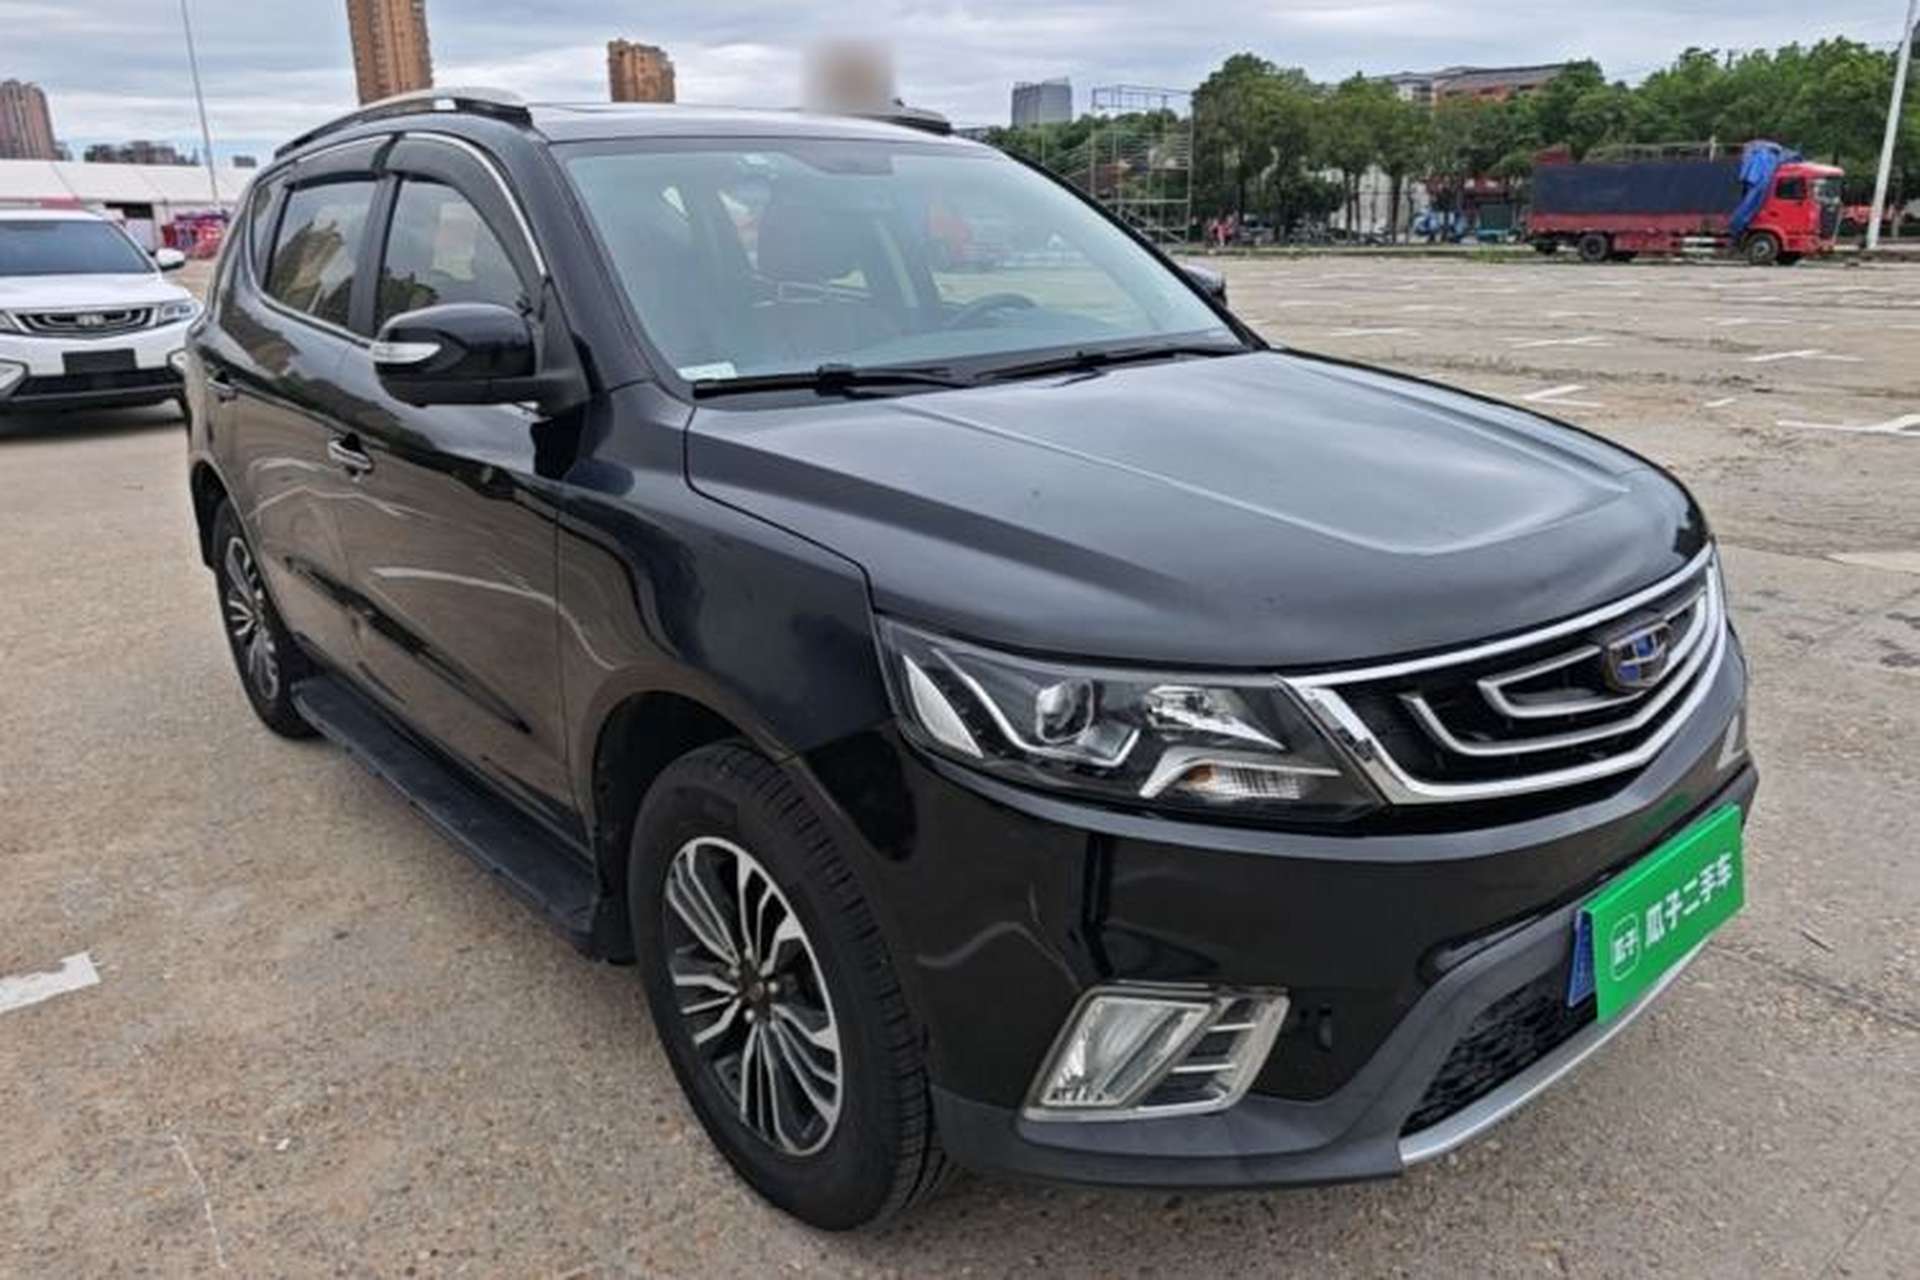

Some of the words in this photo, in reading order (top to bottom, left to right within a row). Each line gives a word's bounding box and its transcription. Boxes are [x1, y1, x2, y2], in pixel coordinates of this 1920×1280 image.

[1645, 852, 1732, 948] 瓜子二手车
